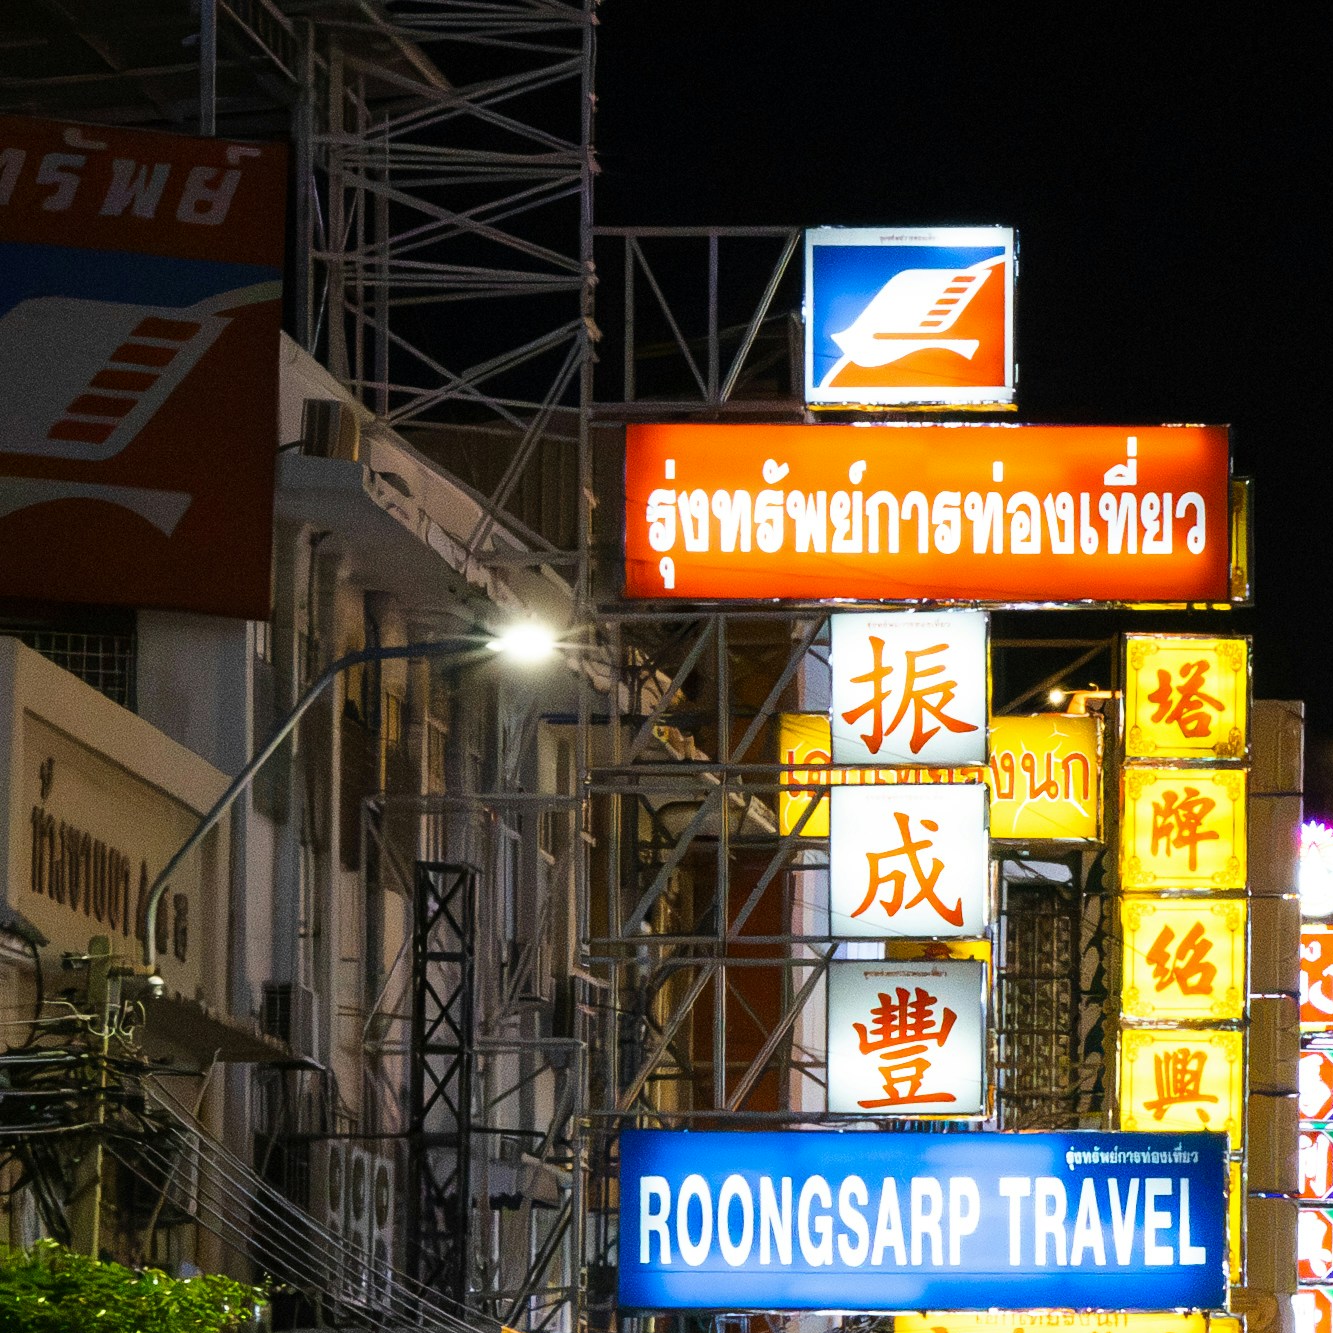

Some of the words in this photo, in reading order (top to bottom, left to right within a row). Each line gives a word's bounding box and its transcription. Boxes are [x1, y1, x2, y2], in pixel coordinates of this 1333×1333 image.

[647, 436, 1205, 589] รุ่งทรัพย์การท่องเที่ยว
[842, 635, 978, 1109] 振成豐
[639, 1174, 981, 1268] ROONGSARP
[1000, 1176, 1206, 1267] TRAVEL
